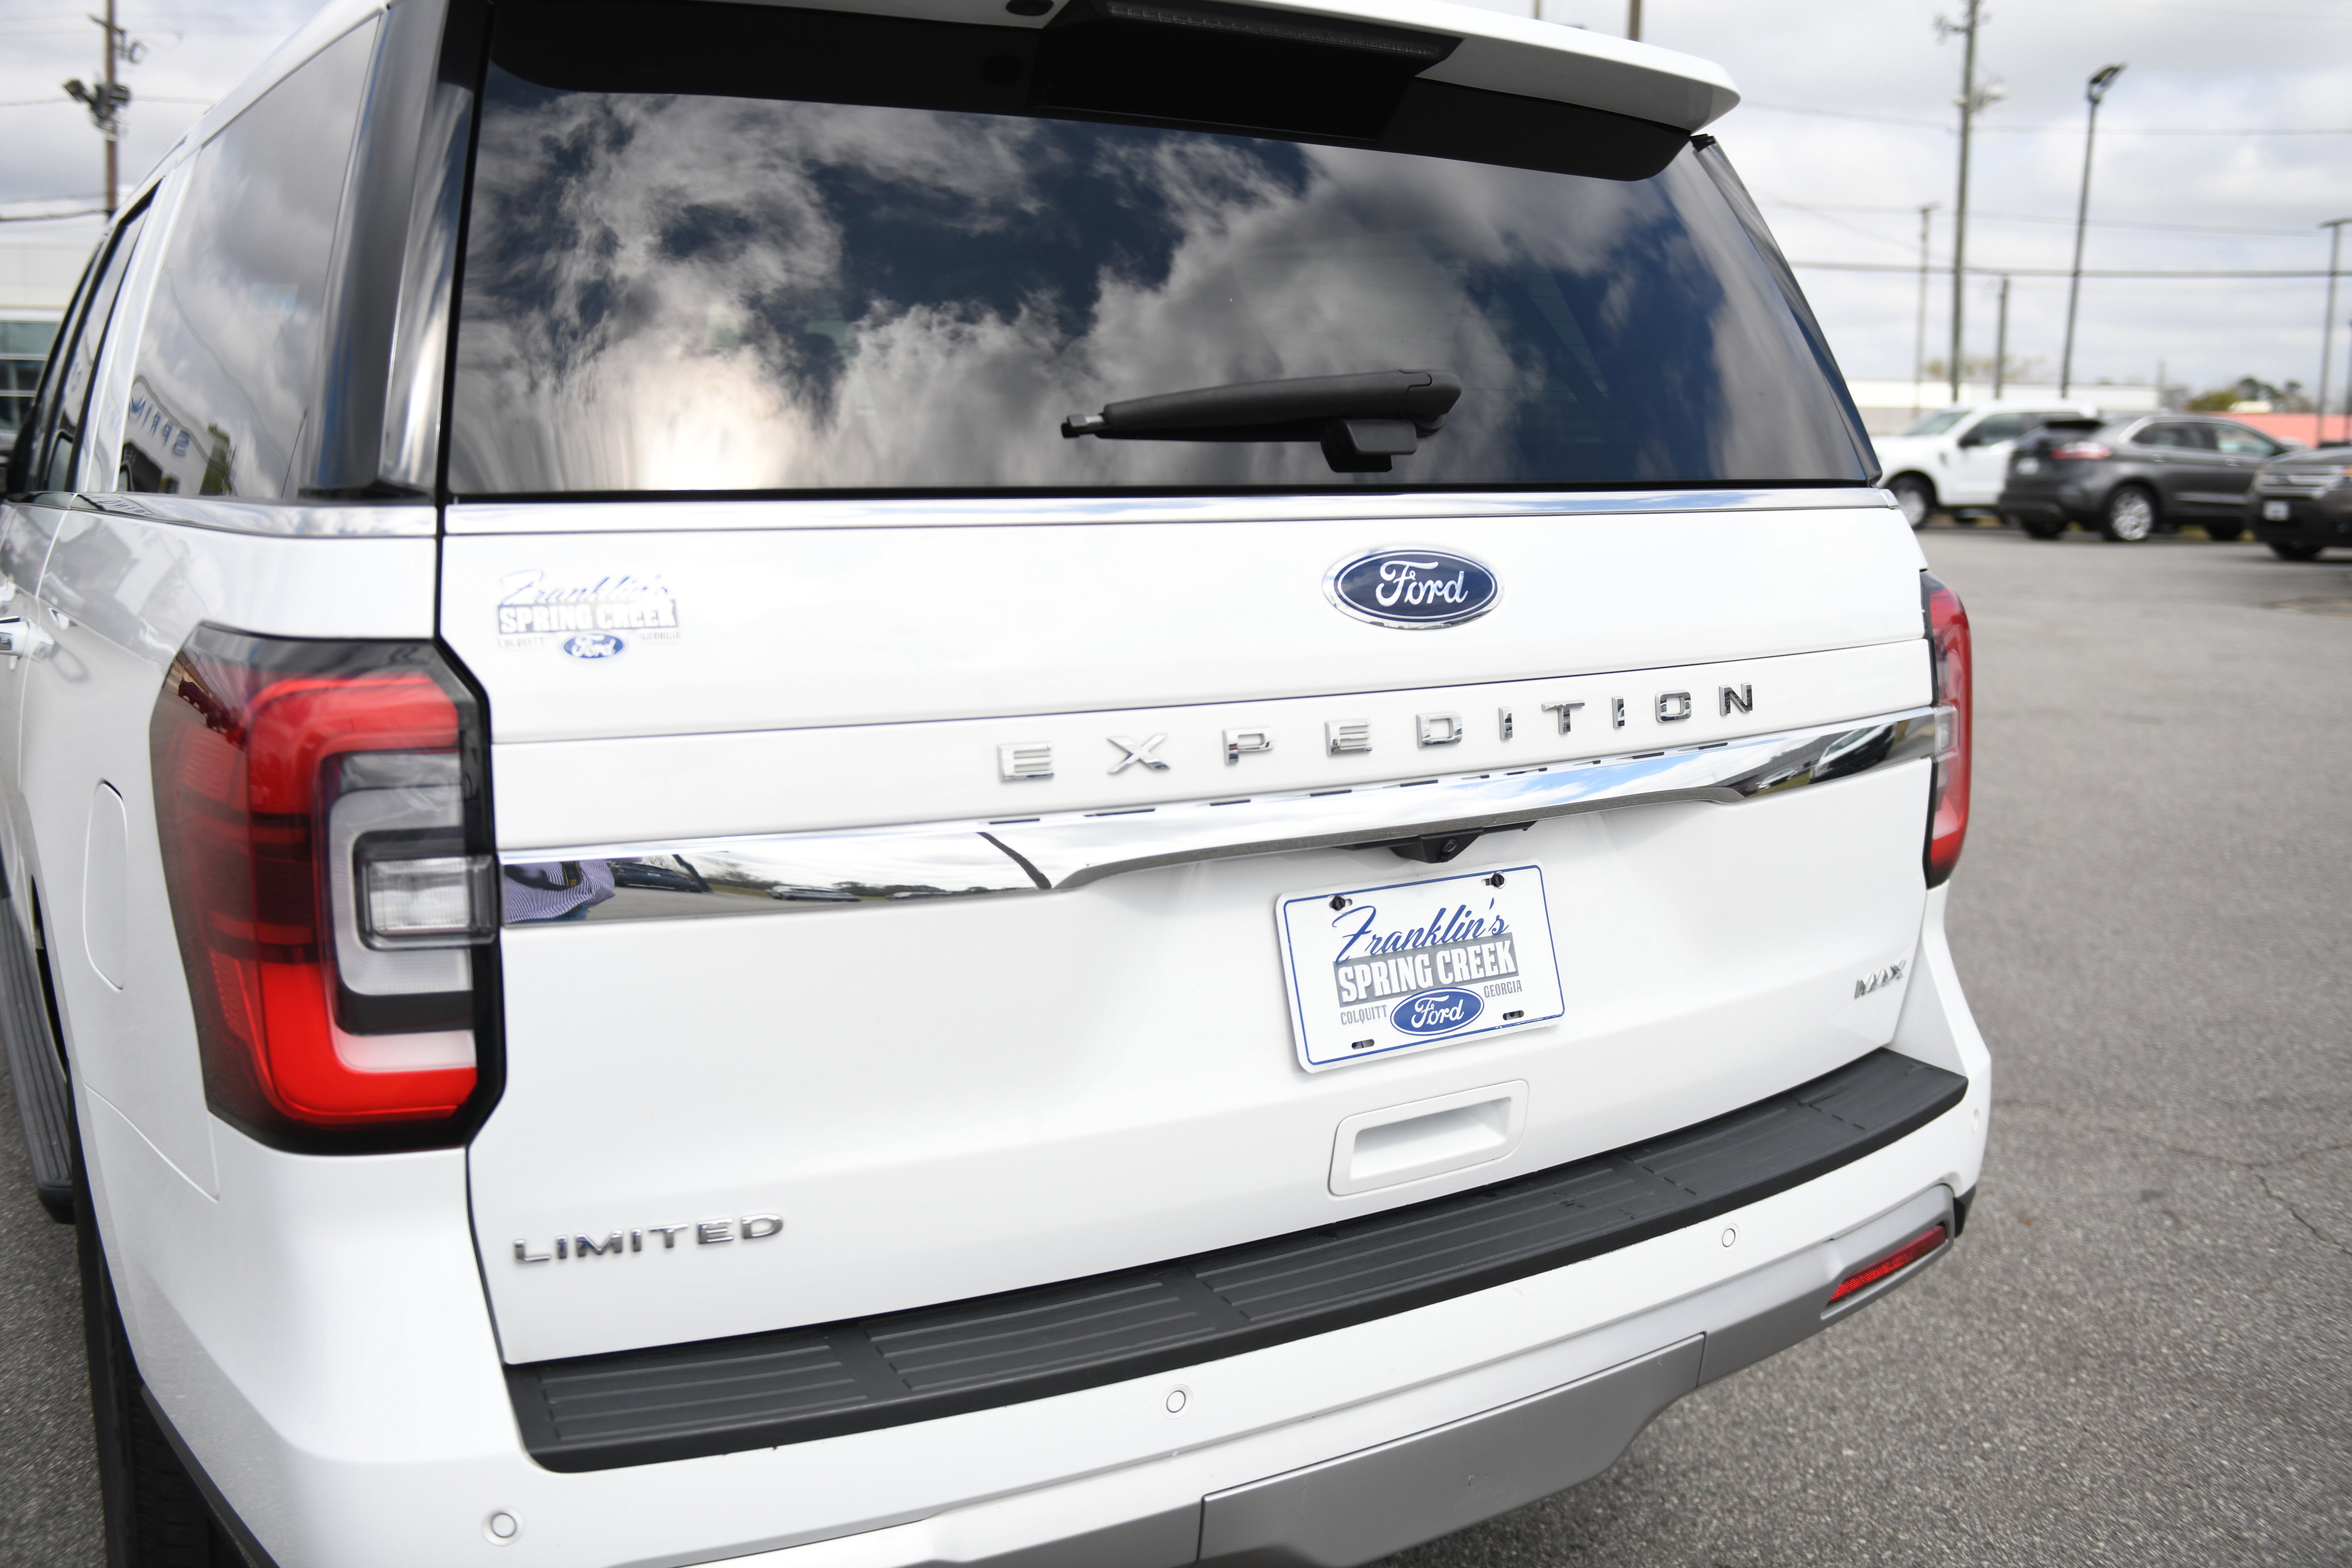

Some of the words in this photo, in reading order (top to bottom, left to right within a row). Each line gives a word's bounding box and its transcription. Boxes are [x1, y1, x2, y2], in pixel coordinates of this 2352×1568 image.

[498, 569, 670, 606] Franklin's
[1375, 560, 1468, 607] Ford
[499, 604, 594, 633] SPRING
[596, 600, 676, 630] CREEK
[572, 634, 616, 657] Ford
[998, 682, 1753, 782] EXPEDITION
[1332, 897, 1509, 964] Franklin's
[1339, 953, 1432, 1002] SPRING
[1436, 939, 1516, 985] CREEK
[1483, 980, 1523, 998] GEORGIA
[1854, 960, 1907, 999] MAX
[1340, 1004, 1388, 1026] COLQUITT
[1410, 995, 1465, 1028] Ford
[514, 1214, 784, 1262] LIMITED
